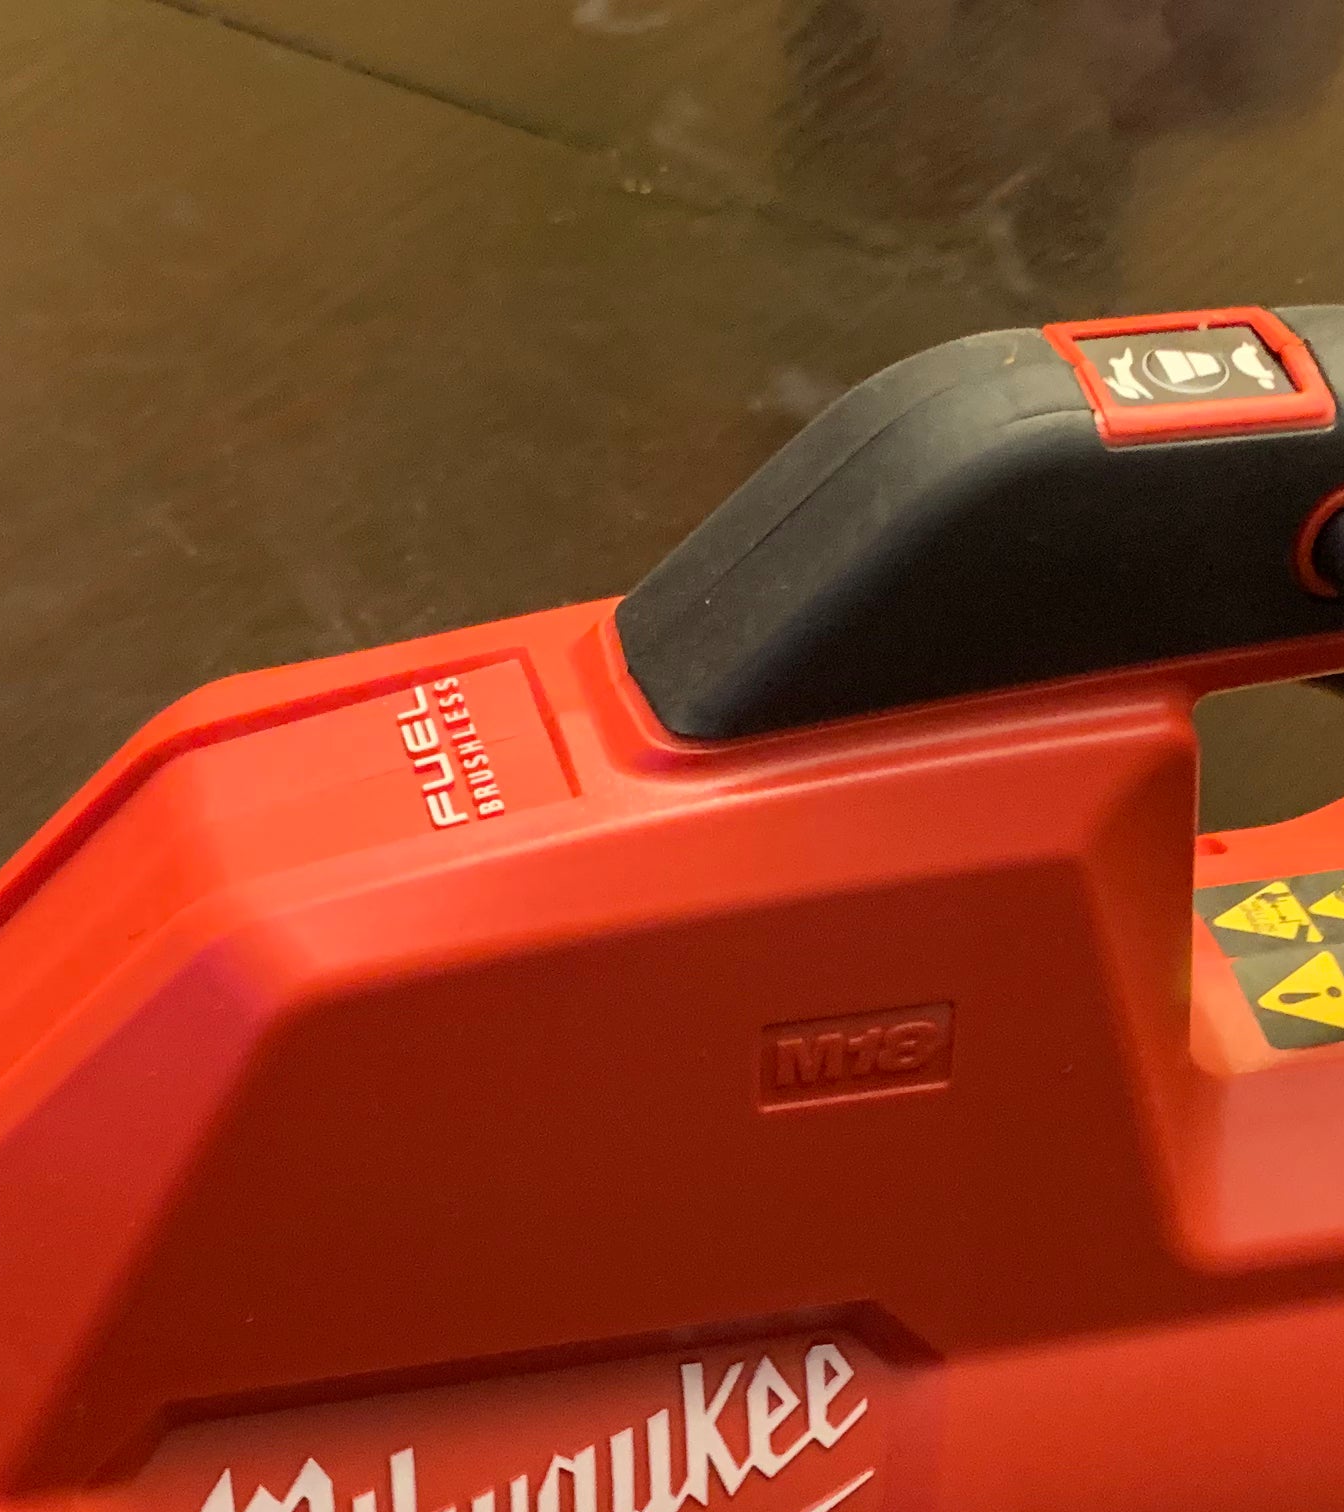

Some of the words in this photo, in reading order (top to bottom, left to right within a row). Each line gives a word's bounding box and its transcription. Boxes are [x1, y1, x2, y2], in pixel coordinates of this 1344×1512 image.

[397, 685, 469, 828] FUEL
[434, 677, 505, 817] BRUSHLESS
[775, 1020, 938, 1088] M18
